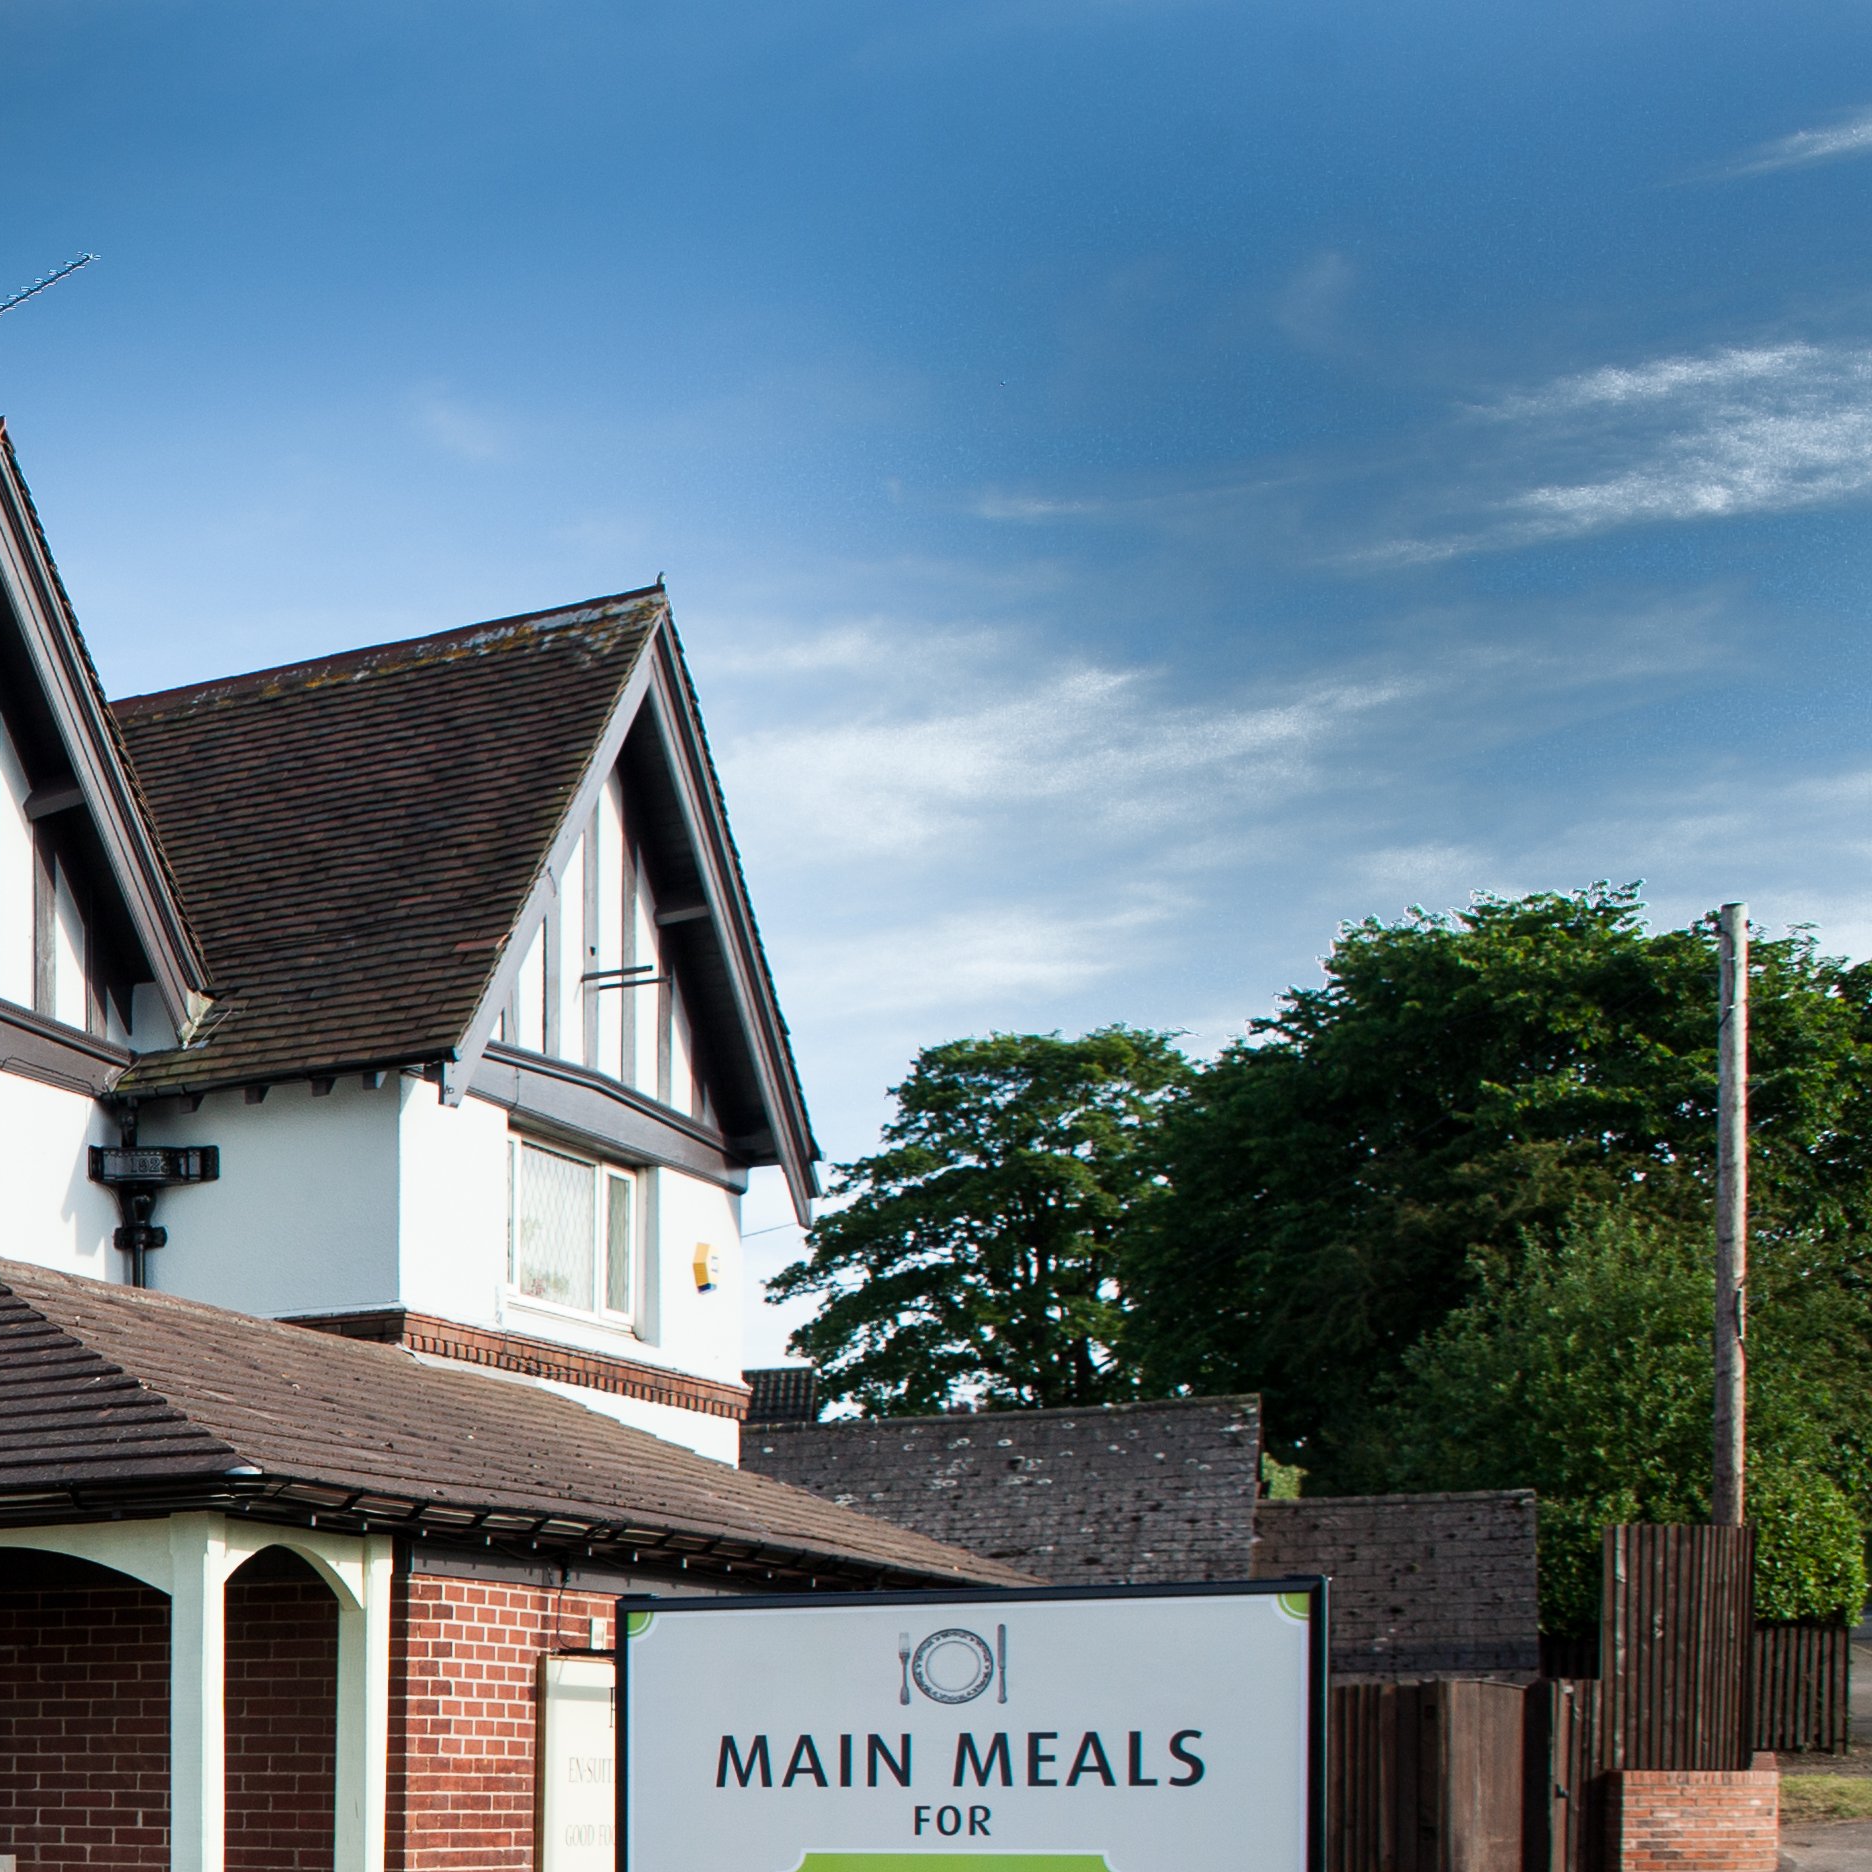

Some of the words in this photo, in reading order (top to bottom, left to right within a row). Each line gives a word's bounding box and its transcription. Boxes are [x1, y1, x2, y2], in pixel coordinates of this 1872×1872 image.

[568, 1756, 615, 1784] EN-SUIT
[716, 1733, 912, 1788] MAIN
[953, 1729, 1206, 1788] MEALS
[913, 1805, 992, 1836] FOR
[565, 1824, 595, 1848] GOOD
